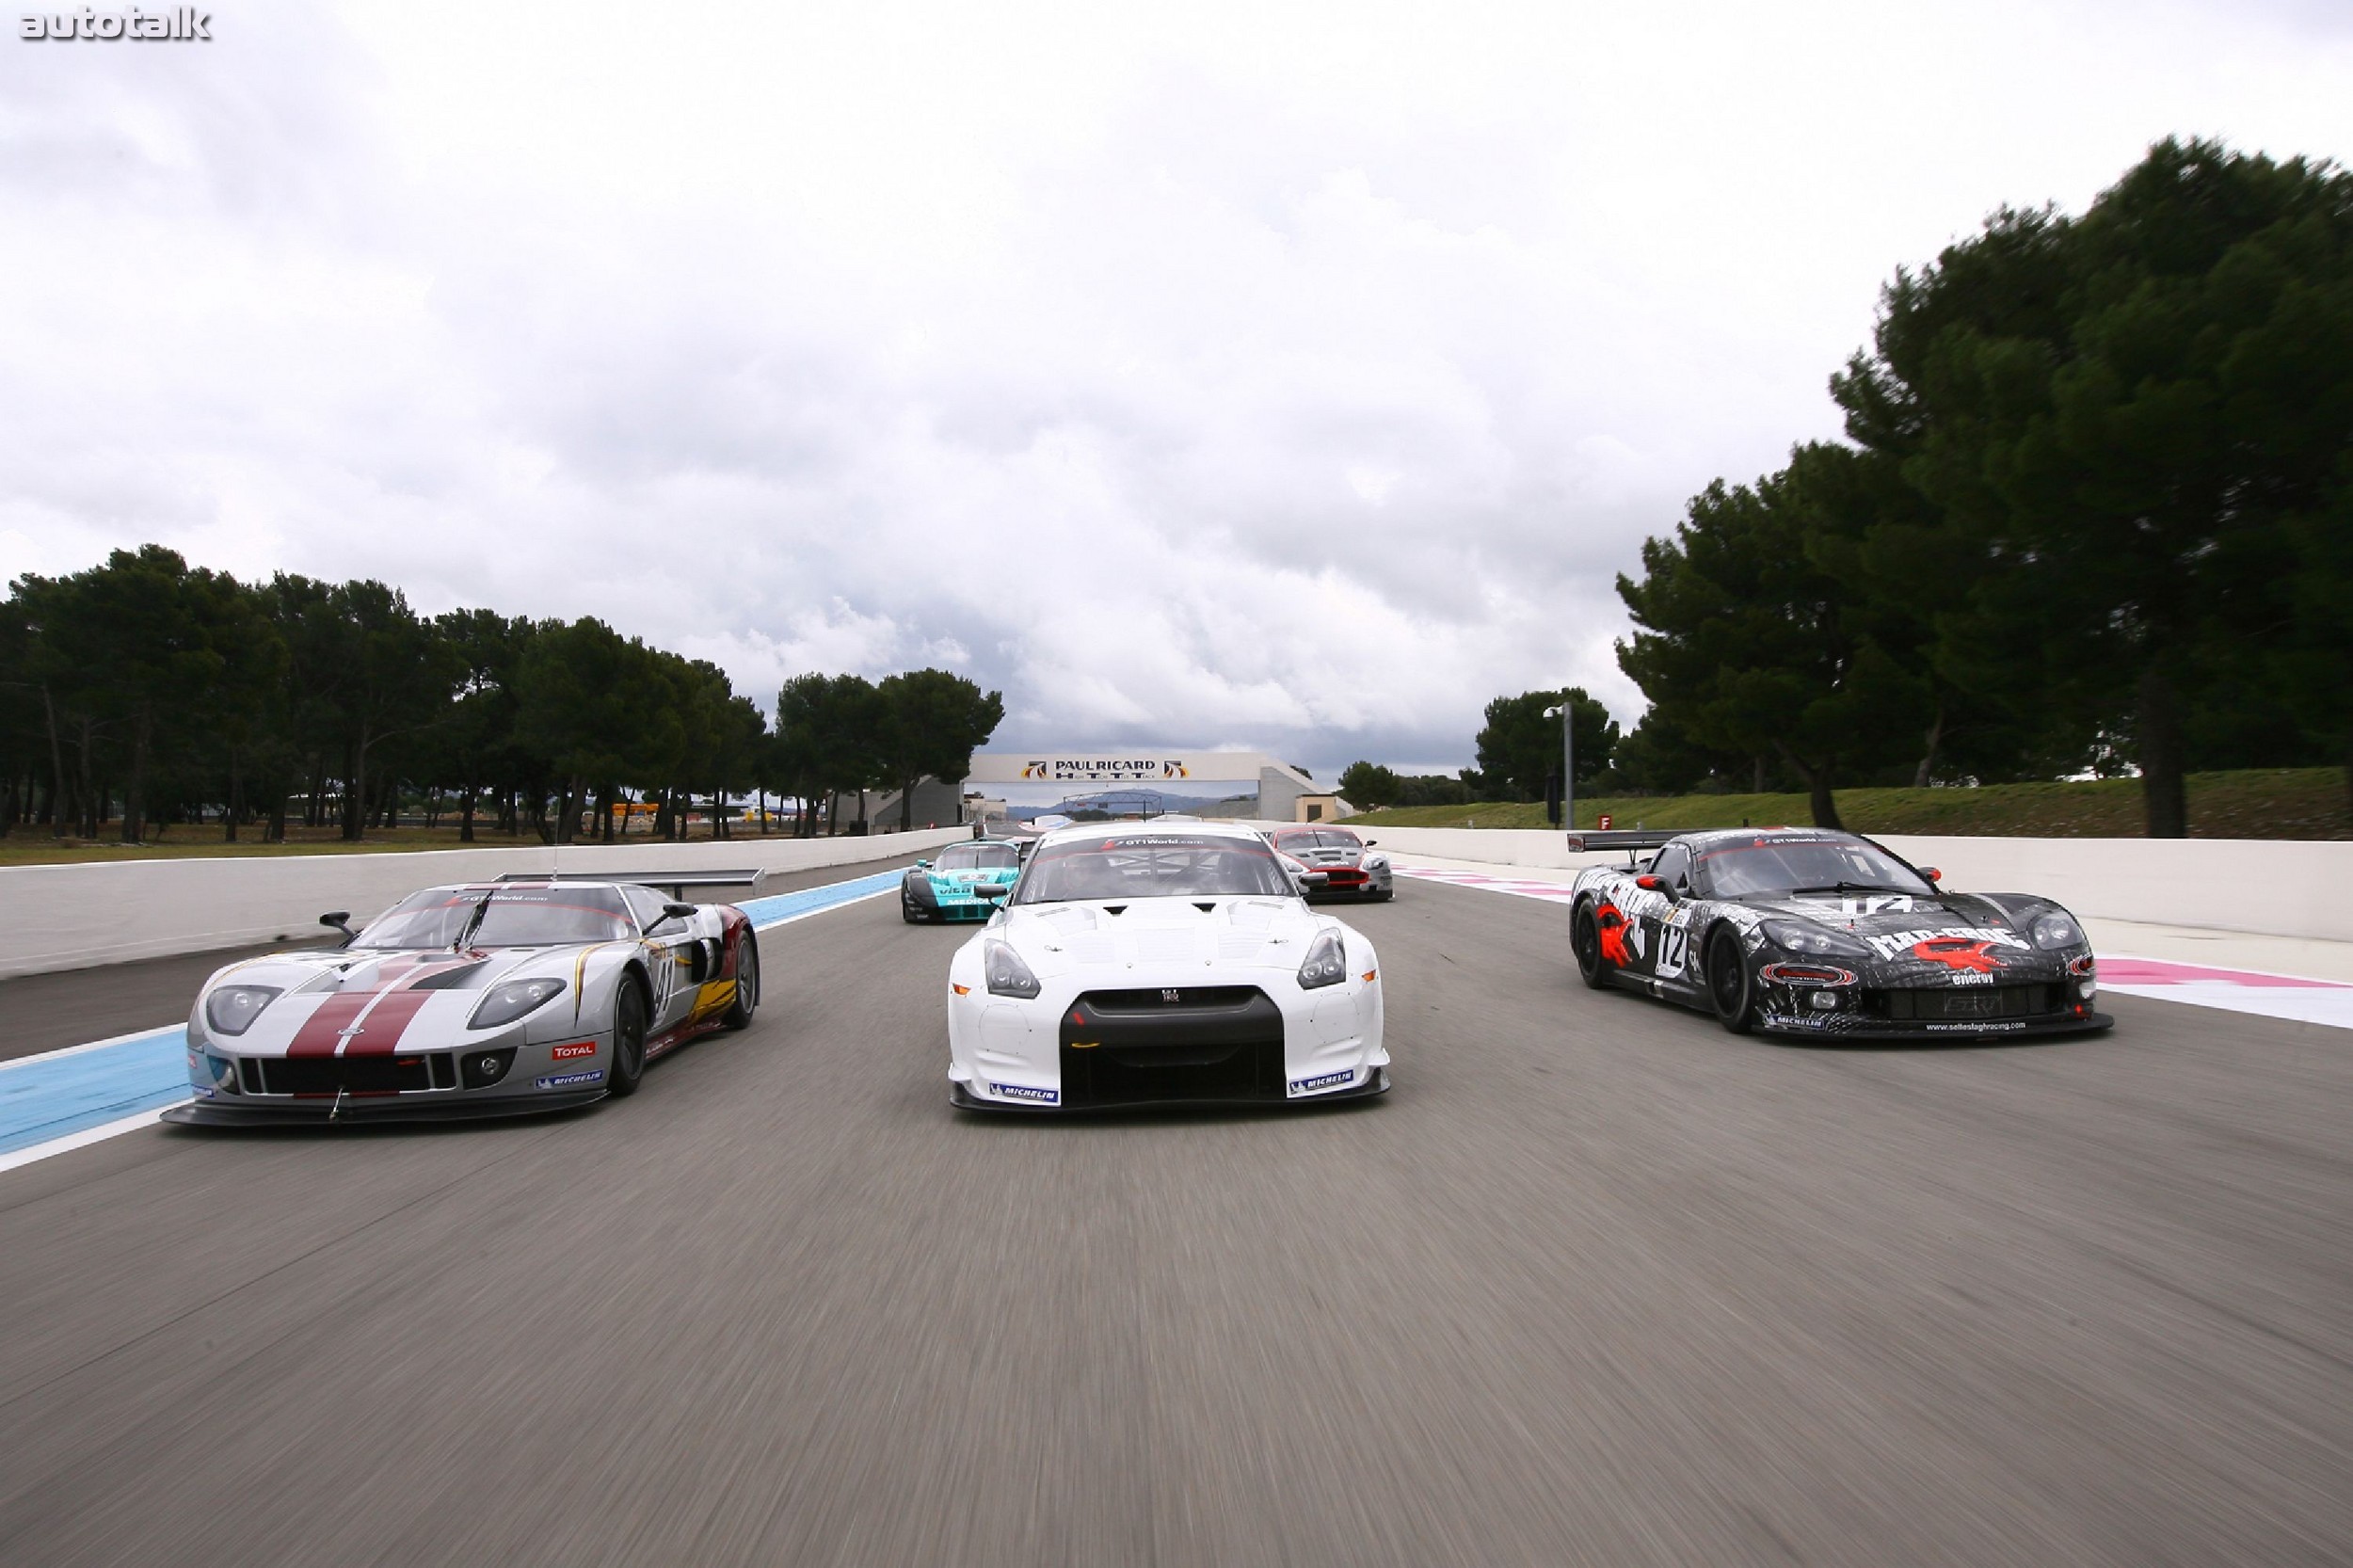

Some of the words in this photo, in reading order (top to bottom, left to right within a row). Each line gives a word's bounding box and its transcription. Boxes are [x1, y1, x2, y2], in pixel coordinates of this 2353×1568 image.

[1056, 760, 1094, 771] PAUL
[1096, 760, 1156, 771] RICARD
[1601, 817, 1610, 829] F
[1662, 925, 1685, 968] 12
[1952, 972, 1994, 986] energy
[1778, 1016, 1822, 1026] MICHELIN
[554, 1046, 593, 1057] TOTAL
[553, 1072, 601, 1084] MICHELIN
[1307, 1072, 1352, 1087] MICHELIN
[1004, 1087, 1055, 1099] MICHELIN
